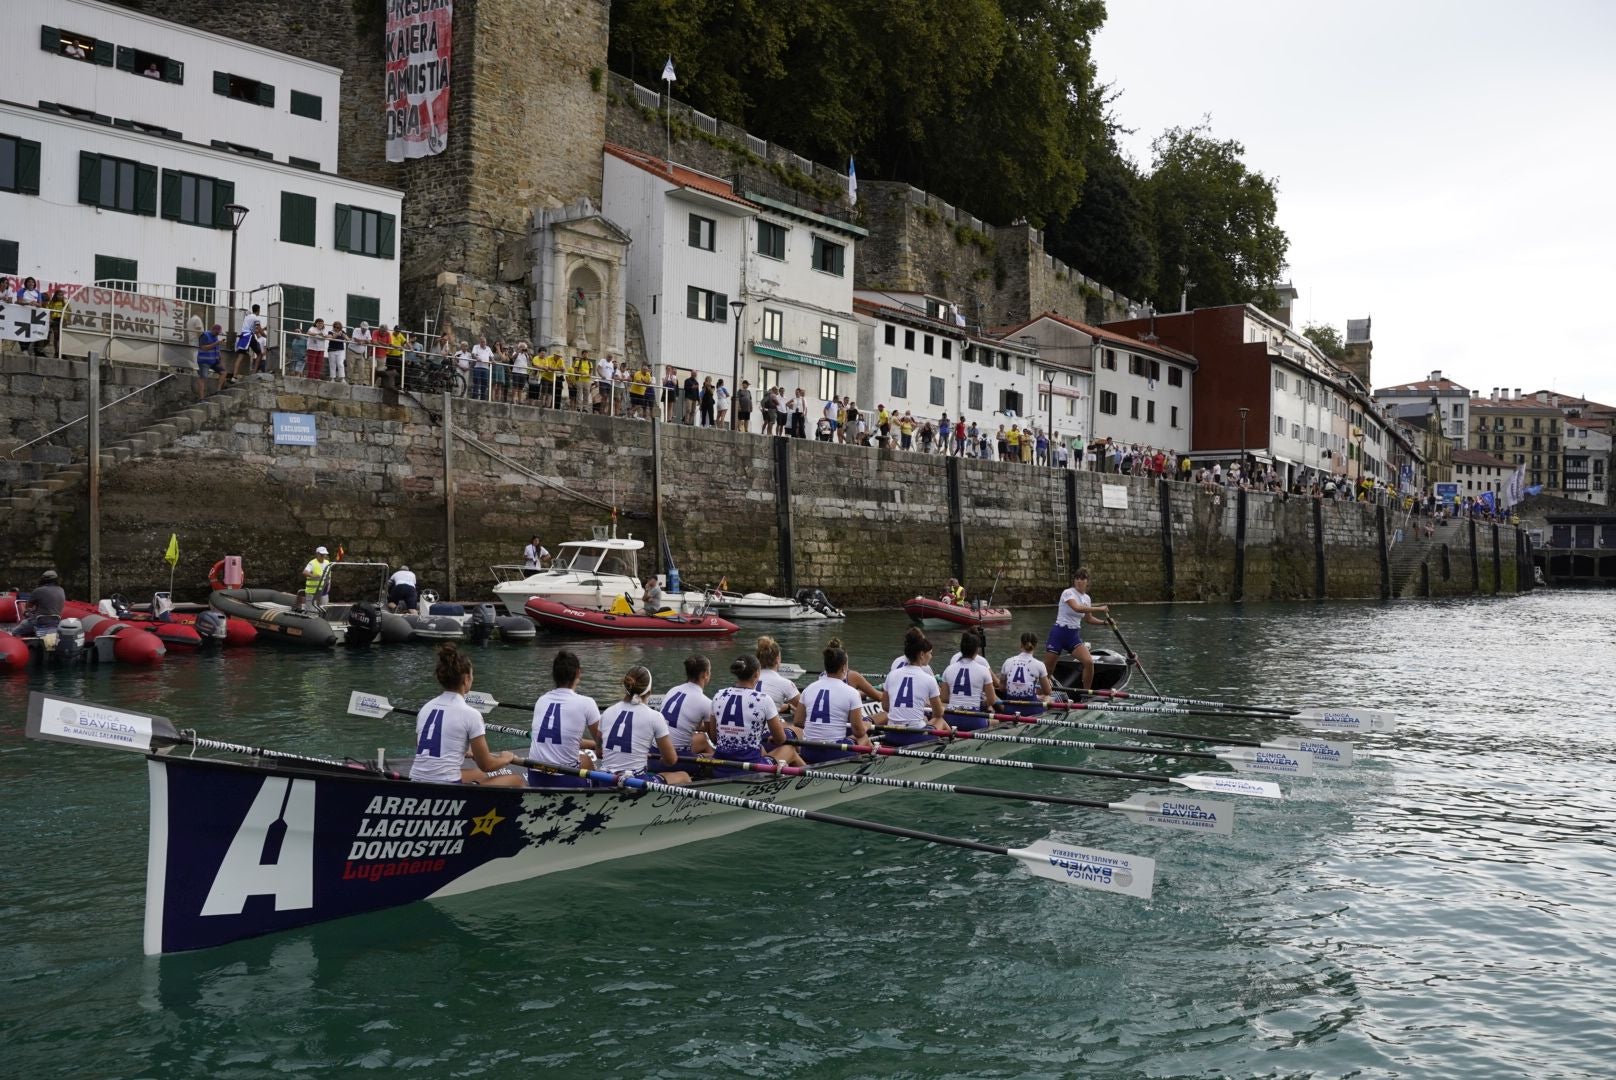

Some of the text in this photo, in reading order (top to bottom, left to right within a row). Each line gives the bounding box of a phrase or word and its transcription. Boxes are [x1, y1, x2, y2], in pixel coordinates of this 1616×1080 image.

[94, 286, 168, 316] SOZIALISTA
[563, 608, 586, 617] PRO
[952, 668, 972, 696] A
[1012, 666, 1026, 684] A
[894, 677, 914, 708] A
[660, 691, 687, 728] A
[720, 694, 745, 727] A
[810, 689, 830, 724] A
[79, 710, 120, 722] CLINICA
[537, 702, 562, 744] A
[79, 717, 137, 734] BAVIERA
[416, 709, 444, 757] A
[605, 710, 633, 753] A
[73, 728, 98, 738] MANUEL
[99, 732, 133, 743] SALABERRIA
[974, 732, 1096, 750] DONOSTIA ARRAUN LAGUNAK
[198, 738, 252, 755] DONOSTIA
[899, 749, 946, 760] DONOSTIA
[1300, 747, 1340, 756] BAVIERA
[1256, 758, 1299, 766] BAVIERA
[805, 770, 859, 782] DONOSTIA
[907, 780, 956, 793] LAGUNAK
[364, 795, 467, 816] ARRAUN
[646, 781, 807, 818] DONOSTIA ARRAUN LAGUNAK
[1163, 802, 1202, 812] CLINICA
[479, 818, 494, 827] 11
[1162, 809, 1217, 821] BAVIERA
[1182, 820, 1215, 828] SALABERRIA
[356, 818, 469, 838] LAGUNAK
[200, 775, 316, 917] A
[347, 839, 465, 860] DONOSTIA
[1052, 849, 1090, 859] SALABERRIA
[1050, 857, 1113, 877] BAVIERA
[1091, 855, 1118, 865] MANUEL
[1066, 869, 1111, 884] CLINICA
